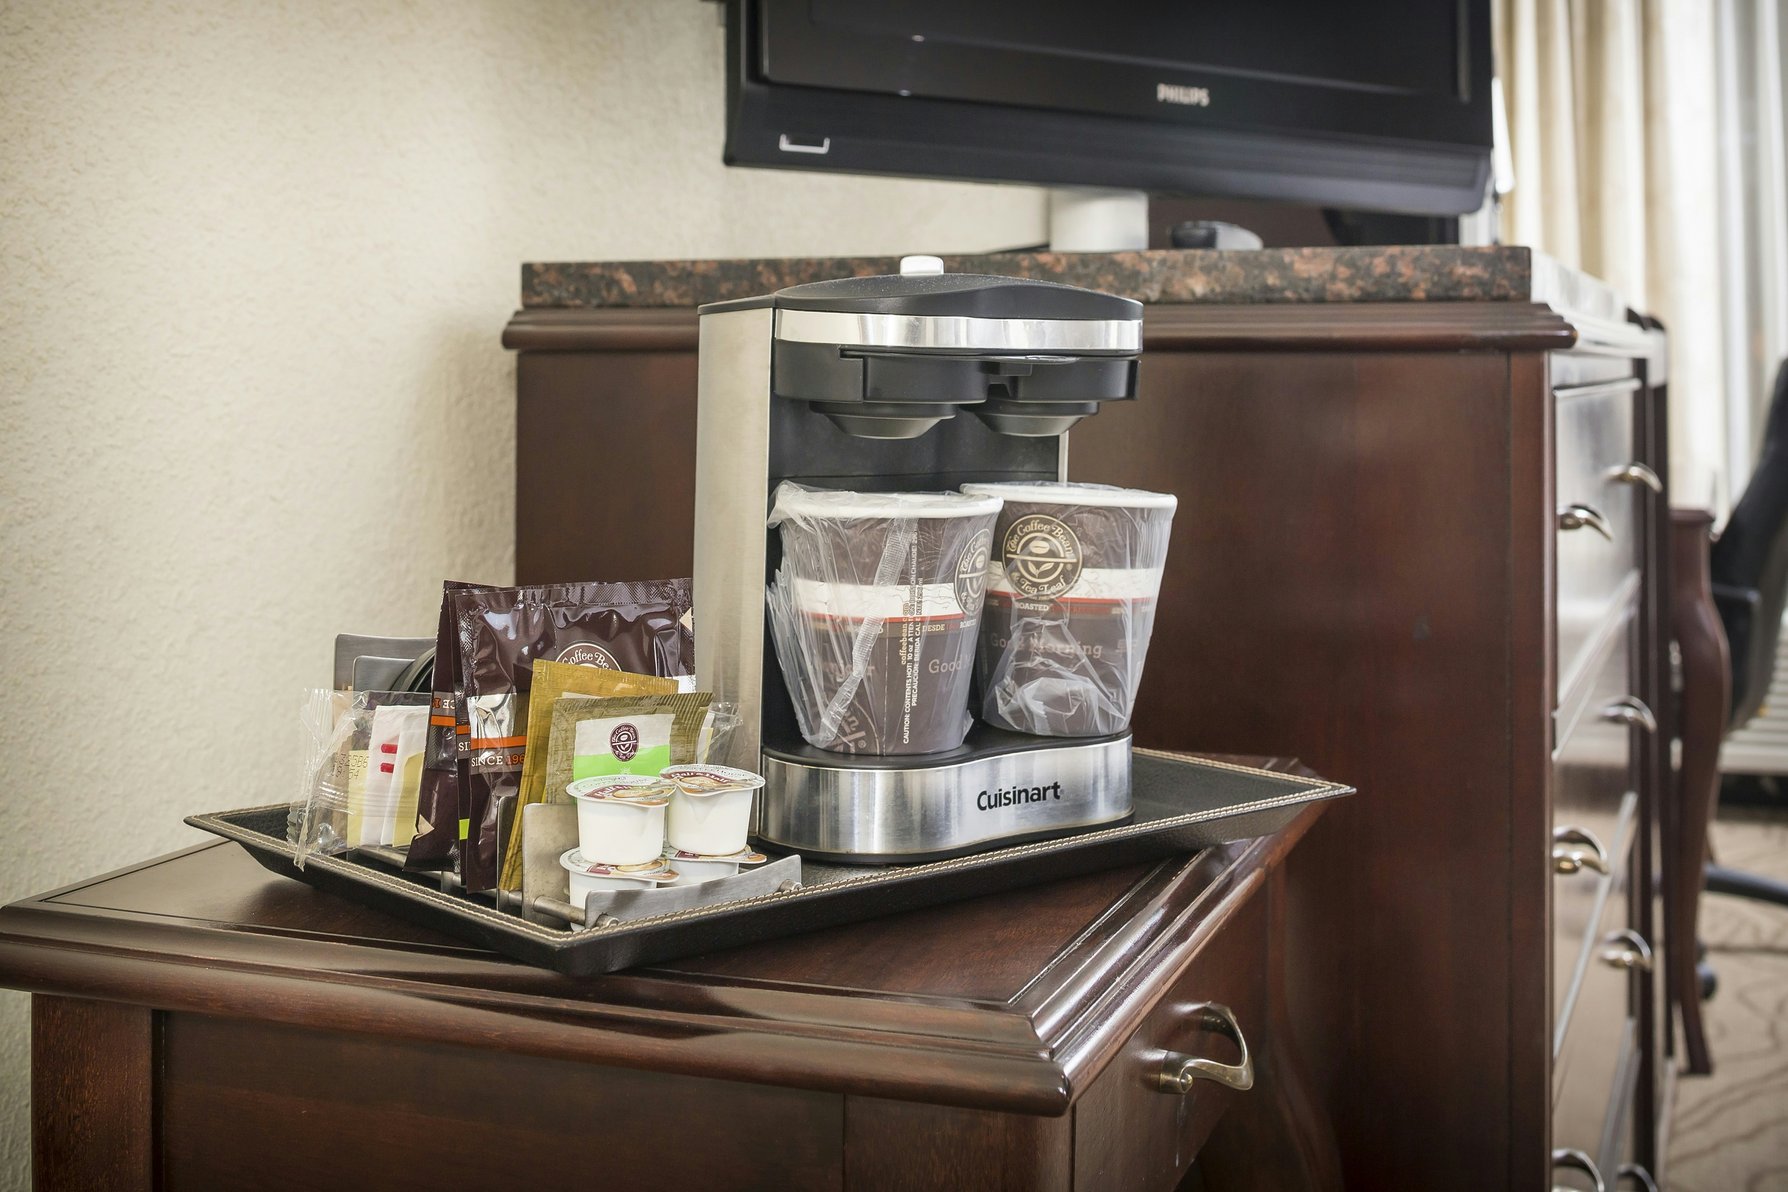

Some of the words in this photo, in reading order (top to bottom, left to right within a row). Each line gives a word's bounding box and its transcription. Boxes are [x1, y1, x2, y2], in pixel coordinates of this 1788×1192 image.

[1157, 83, 1210, 107] PHILIPS
[1016, 520, 1050, 536] Coffee
[1051, 524, 1074, 554] Bean
[1020, 578, 1038, 594] Tea
[1039, 575, 1067, 595] Leaf
[594, 652, 613, 671] Be
[903, 713, 911, 744] CAUTION:
[471, 755, 504, 767] SINCE
[505, 753, 526, 766] 196
[977, 780, 1061, 812] Cuisinart
